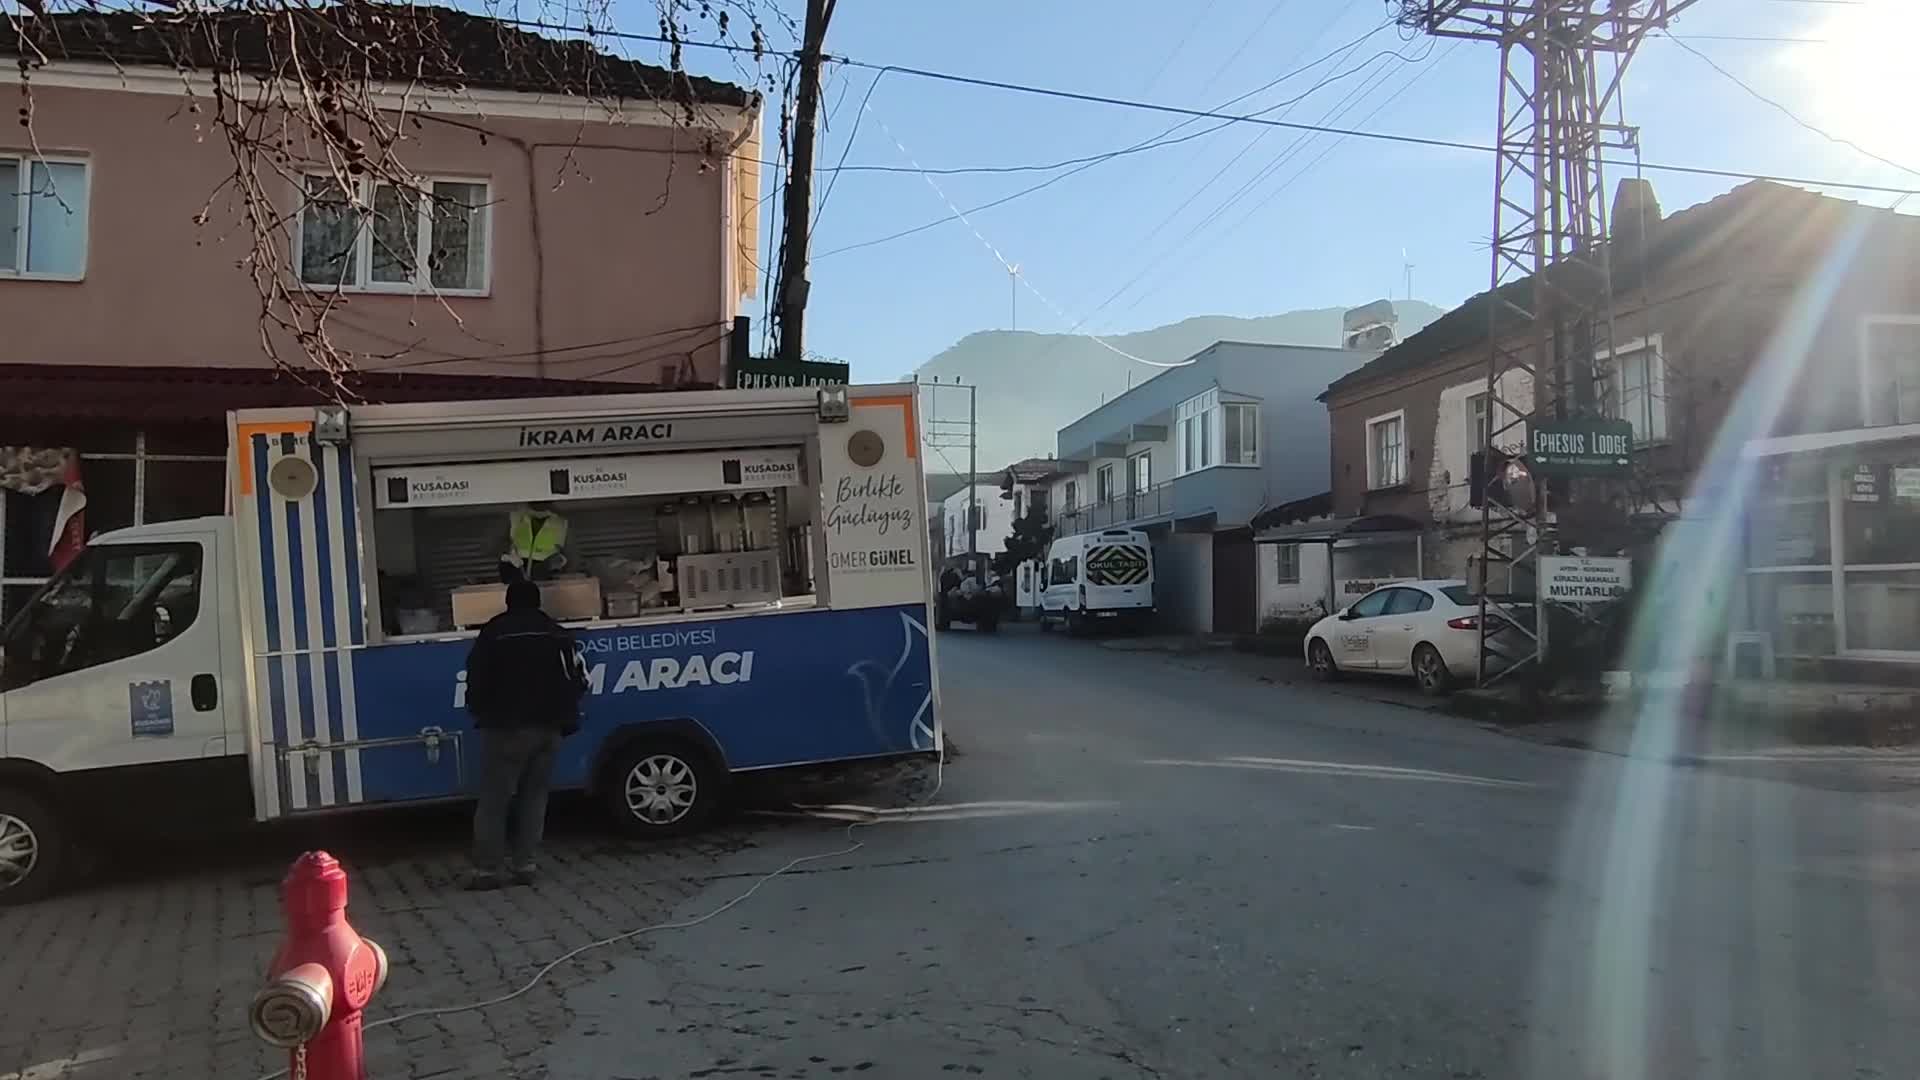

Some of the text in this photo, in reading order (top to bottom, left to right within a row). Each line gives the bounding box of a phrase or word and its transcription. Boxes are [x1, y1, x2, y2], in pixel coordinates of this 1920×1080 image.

[519, 423, 673, 447] İKRAM ARACI
[1533, 429, 1628, 455] EPHESUS LODGE
[836, 474, 904, 503] Birlikte
[869, 549, 915, 566] GÜNEL
[1089, 561, 1112, 569] OKUL
[1584, 576, 1620, 584] MAHALLE
[617, 628, 716, 651] BELEDİYESİ
[612, 651, 755, 693] ARACI
